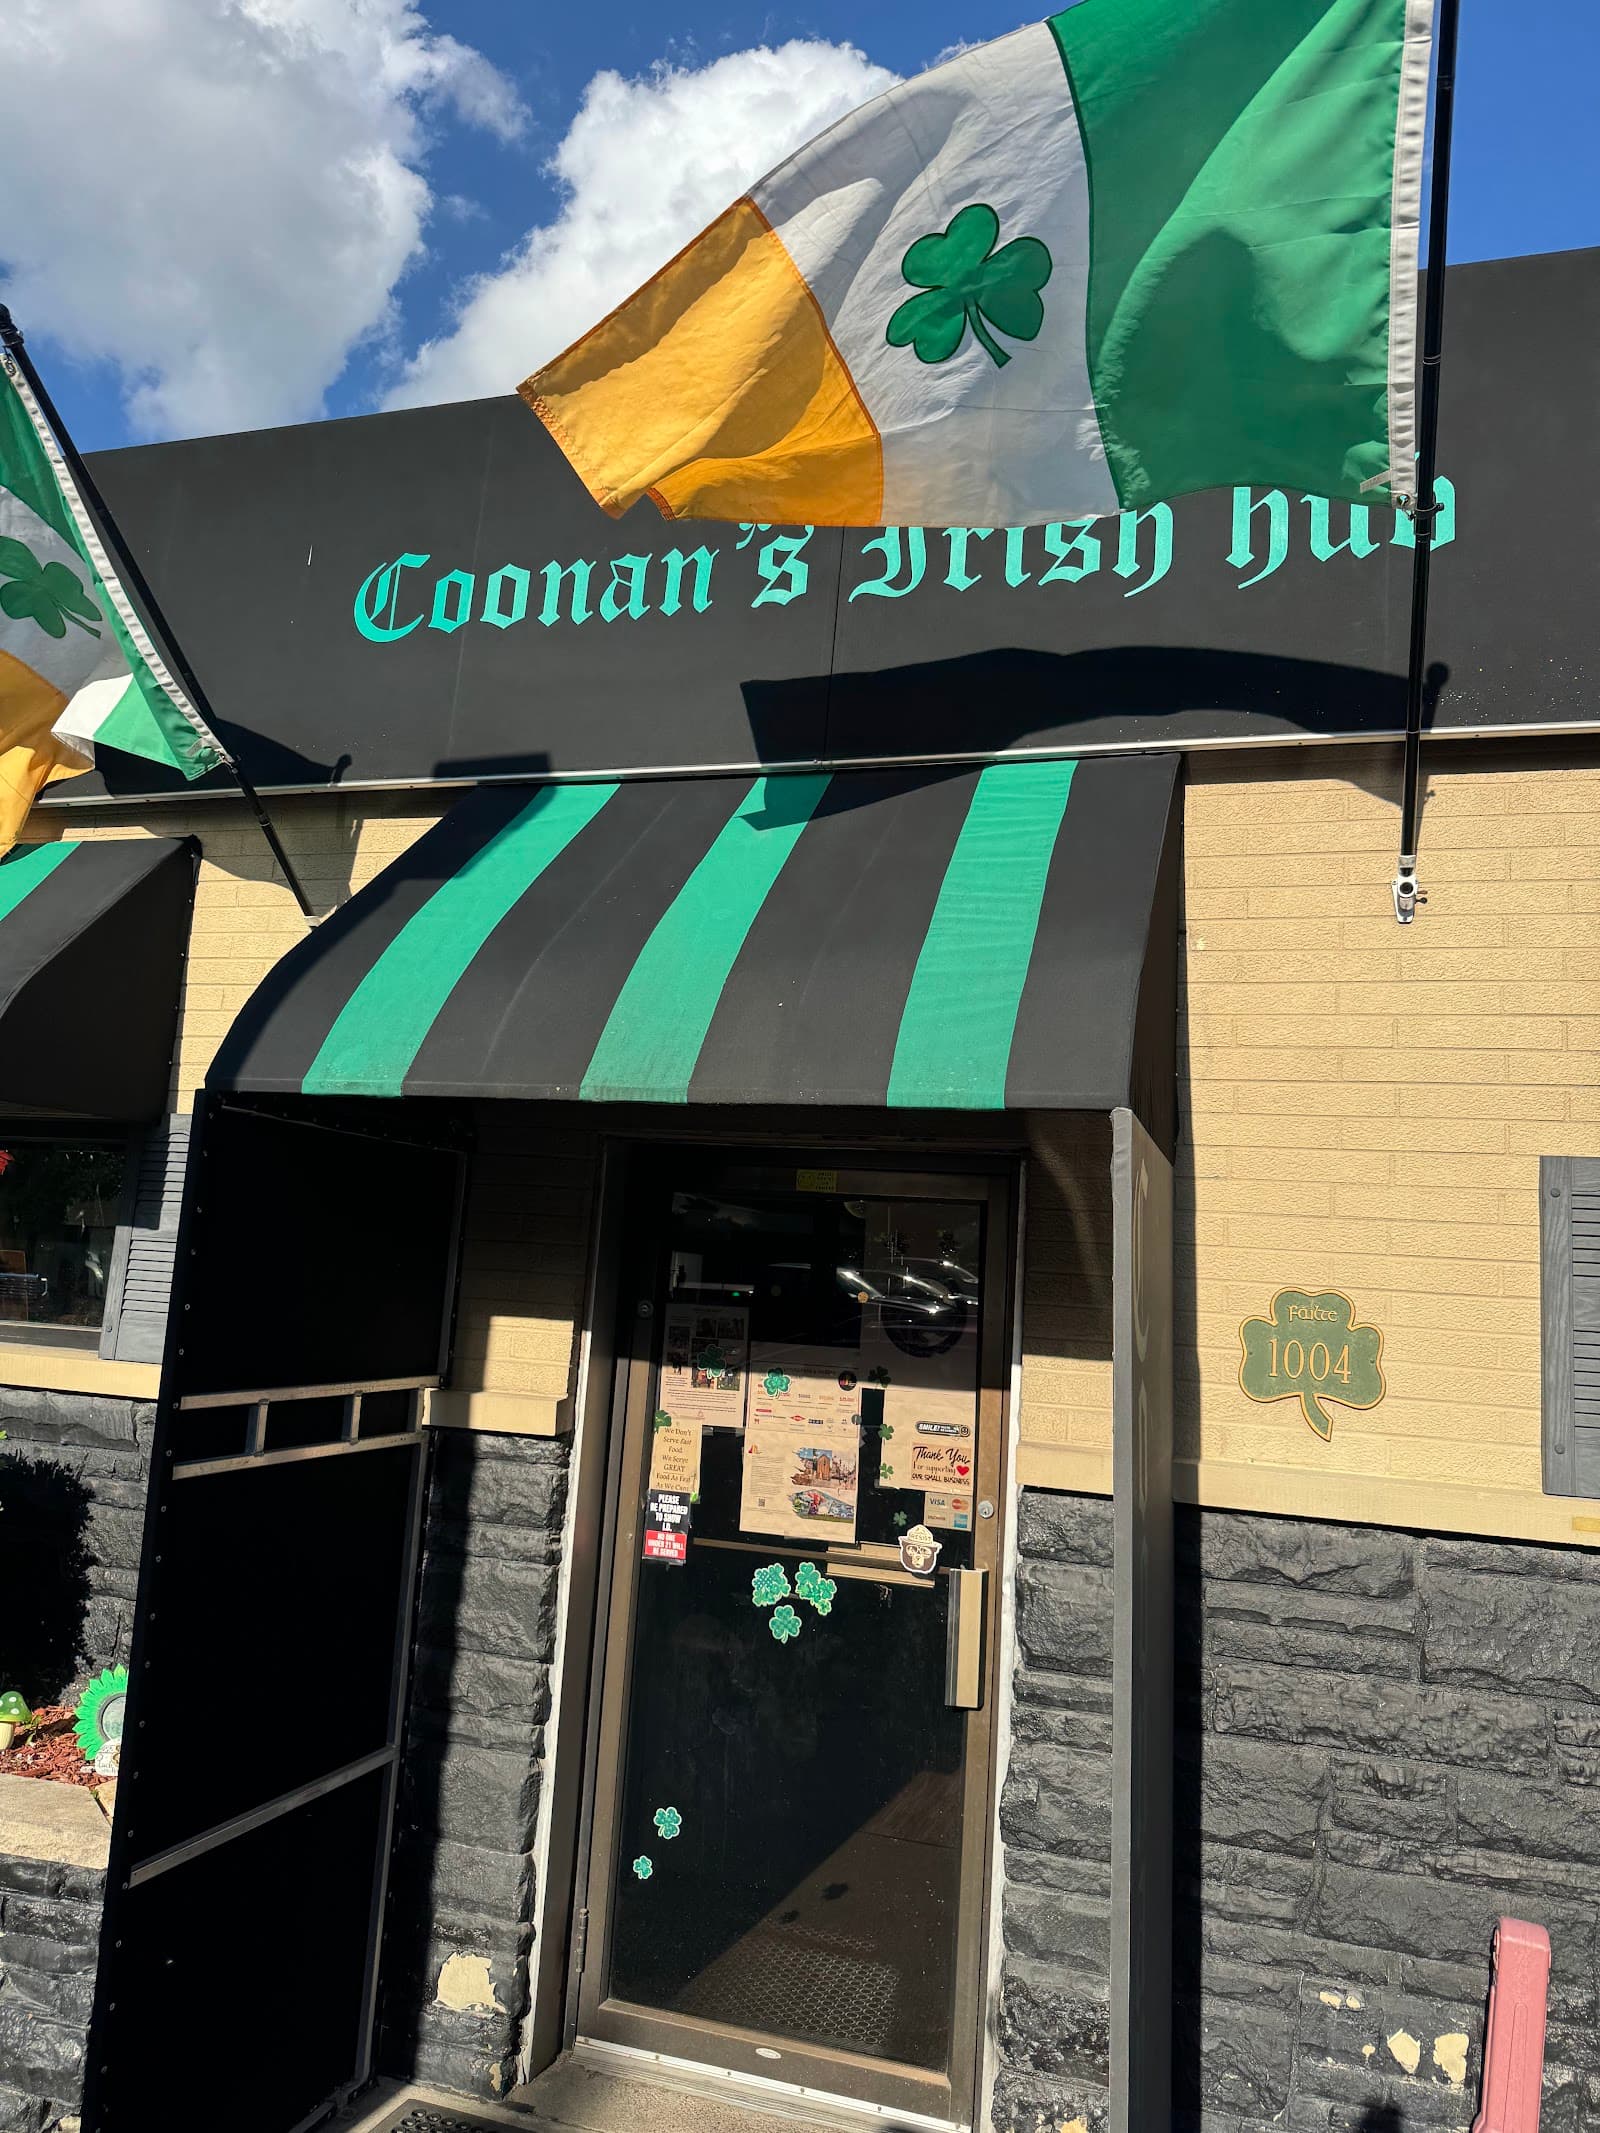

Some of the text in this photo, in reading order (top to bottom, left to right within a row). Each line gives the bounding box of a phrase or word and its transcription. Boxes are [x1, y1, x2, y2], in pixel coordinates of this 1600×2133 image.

[353, 522, 814, 643] Coonan's
[849, 501, 1173, 603] Irish
[1268, 1338, 1352, 1384] 1004
[664, 1436, 678, 1444] Serve
[673, 1456, 688, 1464] Serve
[913, 1446, 970, 1467] Thank You
[664, 1464, 685, 1473] GREAT
[912, 1472, 970, 1485] OUR SMALL BUSINESS
[658, 1494, 680, 1504] PLEASE
[930, 1497, 946, 1506] VISA
[650, 1502, 688, 1515] BE PREPARED
[655, 1511, 681, 1524] TO SHOW
[648, 1539, 684, 1551] UNDER 21 WILL
[652, 1547, 679, 1557] BE SERVED
